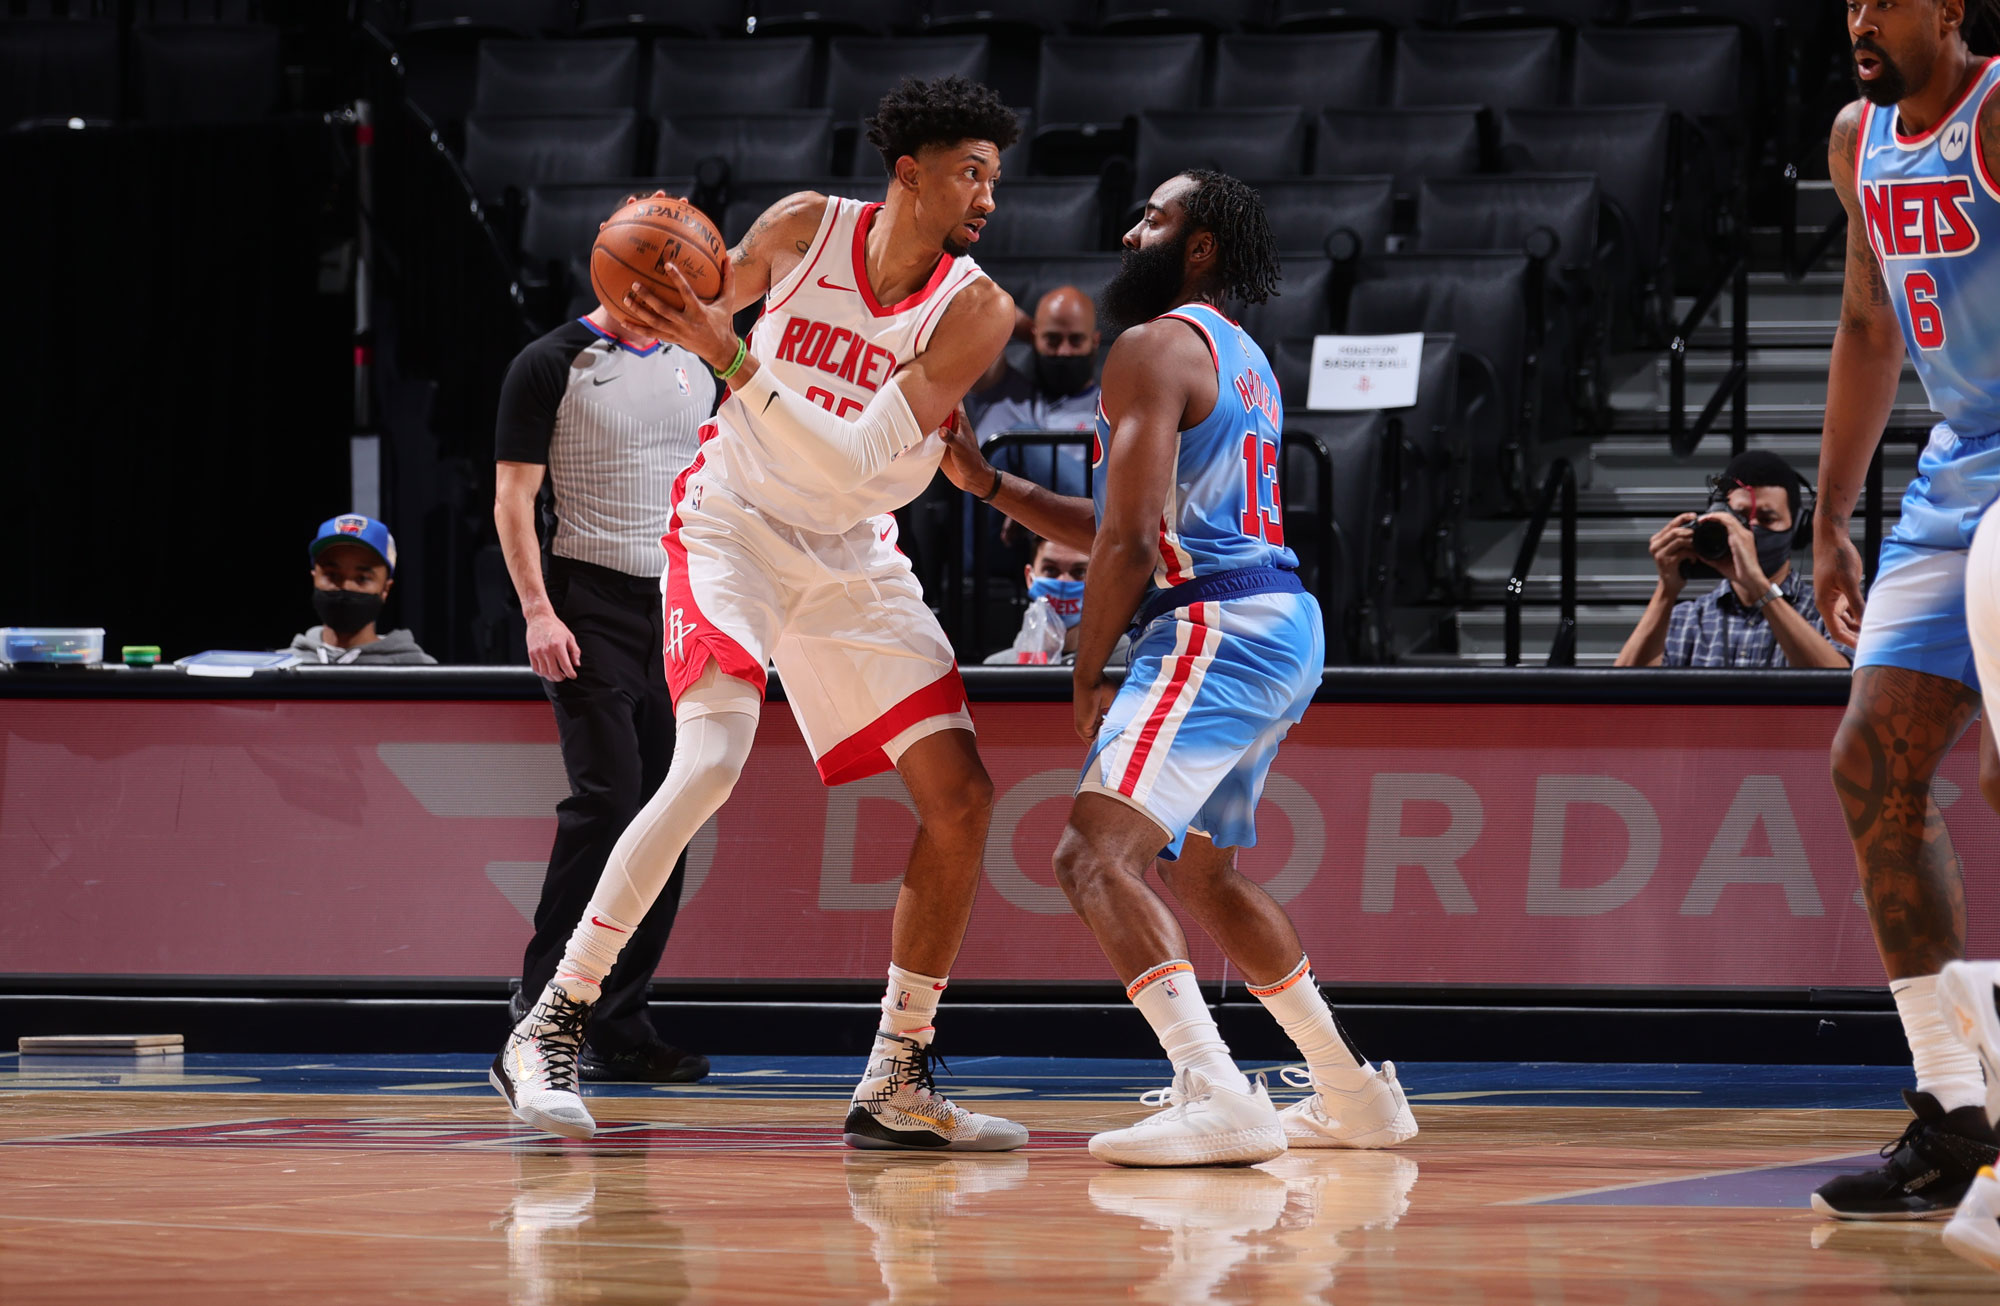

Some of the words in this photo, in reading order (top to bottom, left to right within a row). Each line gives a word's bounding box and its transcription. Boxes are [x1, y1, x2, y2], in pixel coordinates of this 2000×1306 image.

[634, 204, 722, 257] SPALDING
[1862, 175, 1980, 261] NETS
[1904, 270, 1946, 350] 6
[1234, 366, 1279, 433] HRDEN
[1322, 358, 1408, 369] BASKETBALL
[1241, 431, 1284, 550] 13
